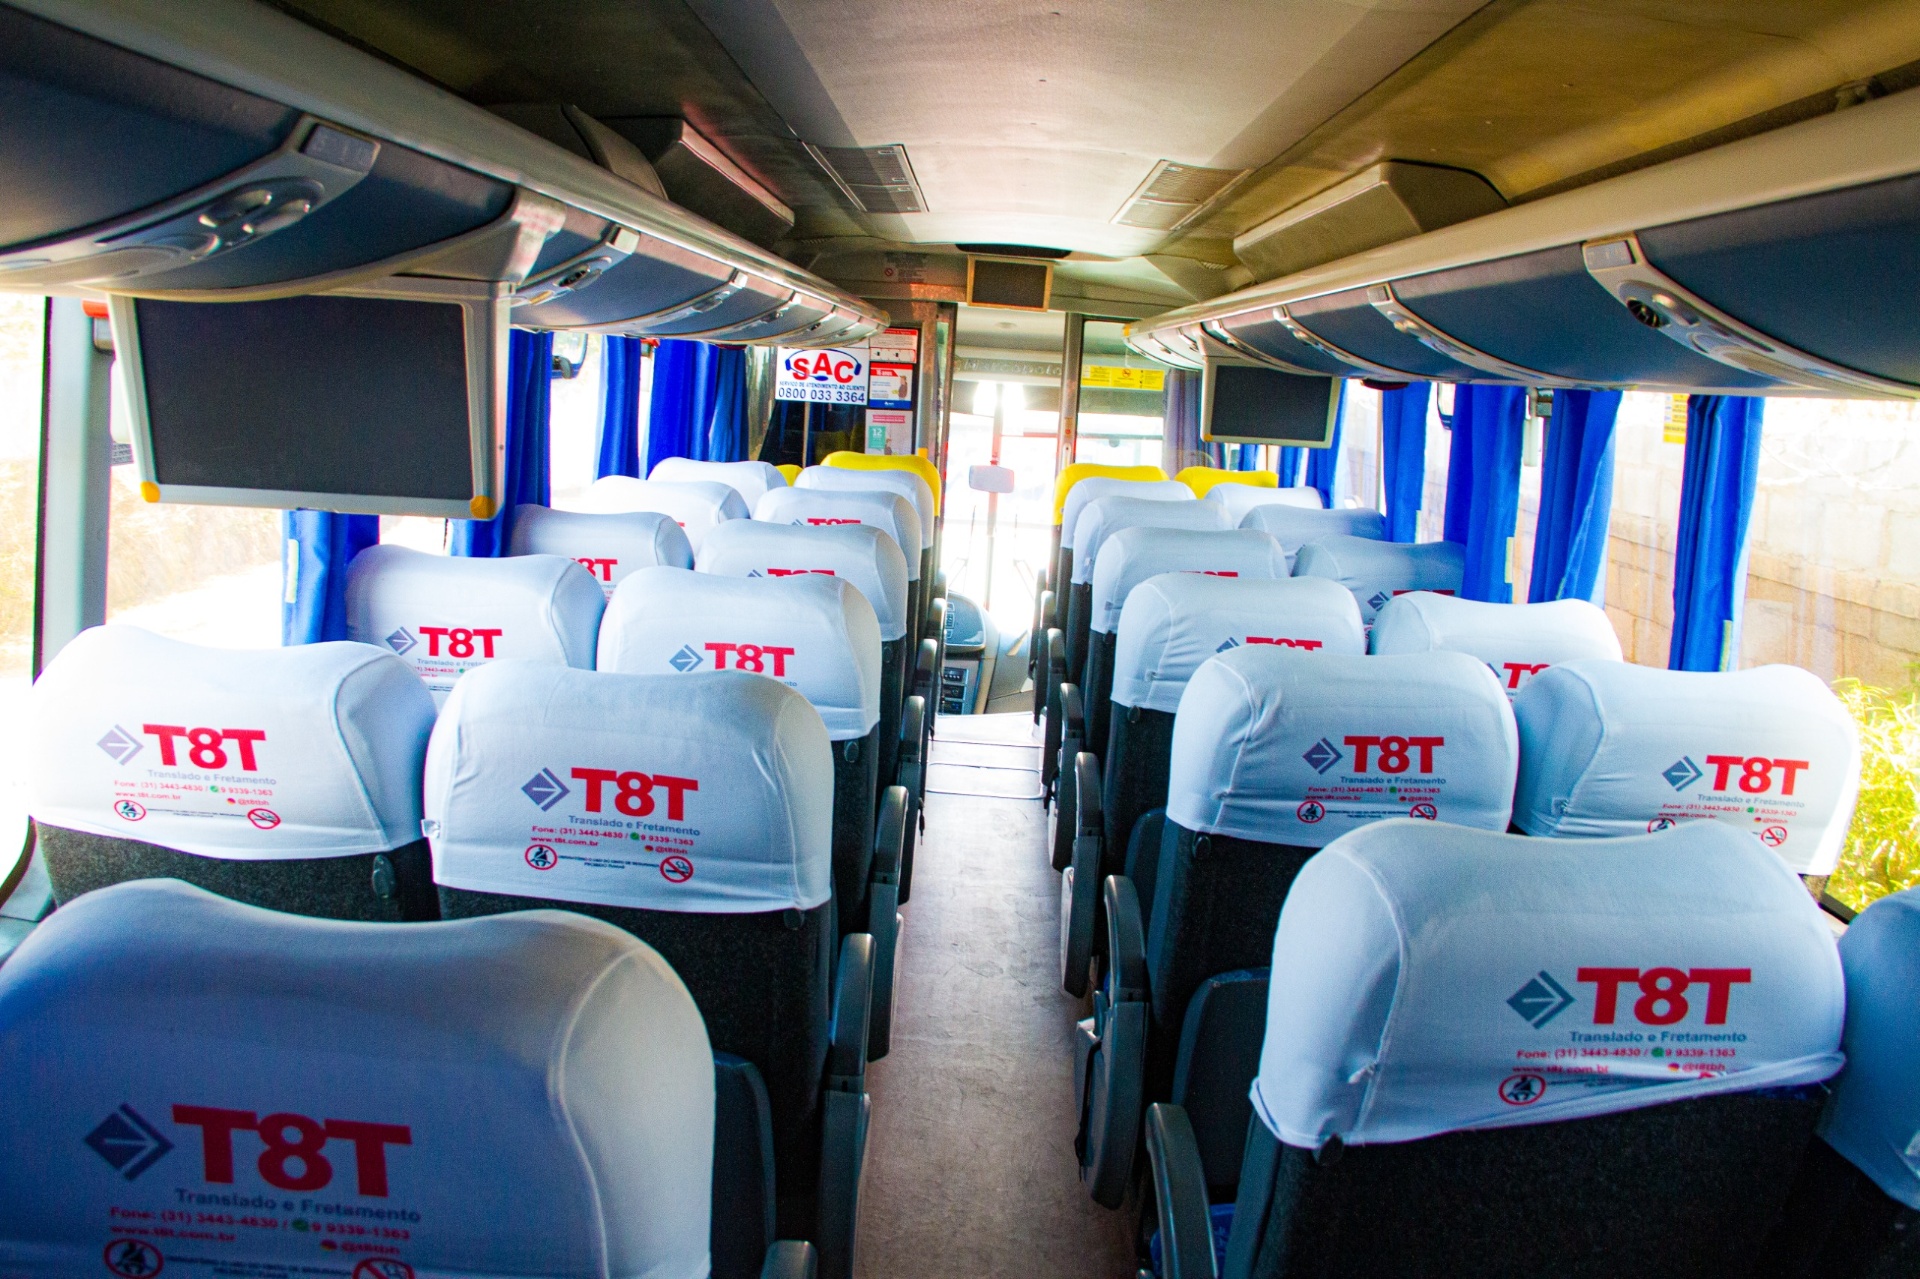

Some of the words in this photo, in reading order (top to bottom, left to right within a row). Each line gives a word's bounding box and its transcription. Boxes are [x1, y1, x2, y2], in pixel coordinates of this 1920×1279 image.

[793, 353, 854, 383] SAC
[779, 387, 806, 399] 0800
[811, 389, 831, 400] 033
[836, 391, 865, 402] 3364
[570, 558, 618, 581] 8T
[419, 626, 503, 658] T8T
[705, 642, 795, 677] T8T
[143, 724, 266, 771] T8T
[1344, 735, 1444, 774] T8T
[148, 770, 201, 781] Translado
[214, 773, 276, 786] Fretamento
[1340, 776, 1384, 784] Translado
[1394, 776, 1446, 784] Fretamento
[1706, 754, 1809, 796] T8T
[141, 781, 157, 789] (31)
[160, 783, 203, 792] 3443-4830
[229, 788, 273, 796] 9339-1363
[570, 767, 698, 821] T8T
[1698, 794, 1742, 804] Translado
[1753, 797, 1805, 808] Fretamento
[532, 825, 557, 834] Fone:
[560, 827, 576, 836] (31)
[579, 829, 623, 839] 3443-4830
[649, 835, 694, 846] 9339-1363
[568, 815, 623, 828] Translado
[626, 821, 632, 829] e
[636, 821, 700, 836] Fretamento
[531, 836, 599, 846] www.t8t.com.br
[1577, 967, 1752, 1025] T8T
[1570, 1031, 1643, 1043] Translado
[1648, 1034, 1656, 1043] e
[1660, 1031, 1747, 1043] Fretamento
[1554, 1048, 1577, 1059] (31)
[1580, 1047, 1640, 1058] 3443-4830
[1676, 1048, 1736, 1058] 9339-1363
[171, 1103, 412, 1198] T8T
[176, 1188, 276, 1210] Translado
[282, 1200, 294, 1211] e
[301, 1200, 420, 1223] Fretamento
[161, 1209, 192, 1225] (31)
[197, 1212, 278, 1228] 3443-4830
[327, 1224, 410, 1241] 9339-1363
